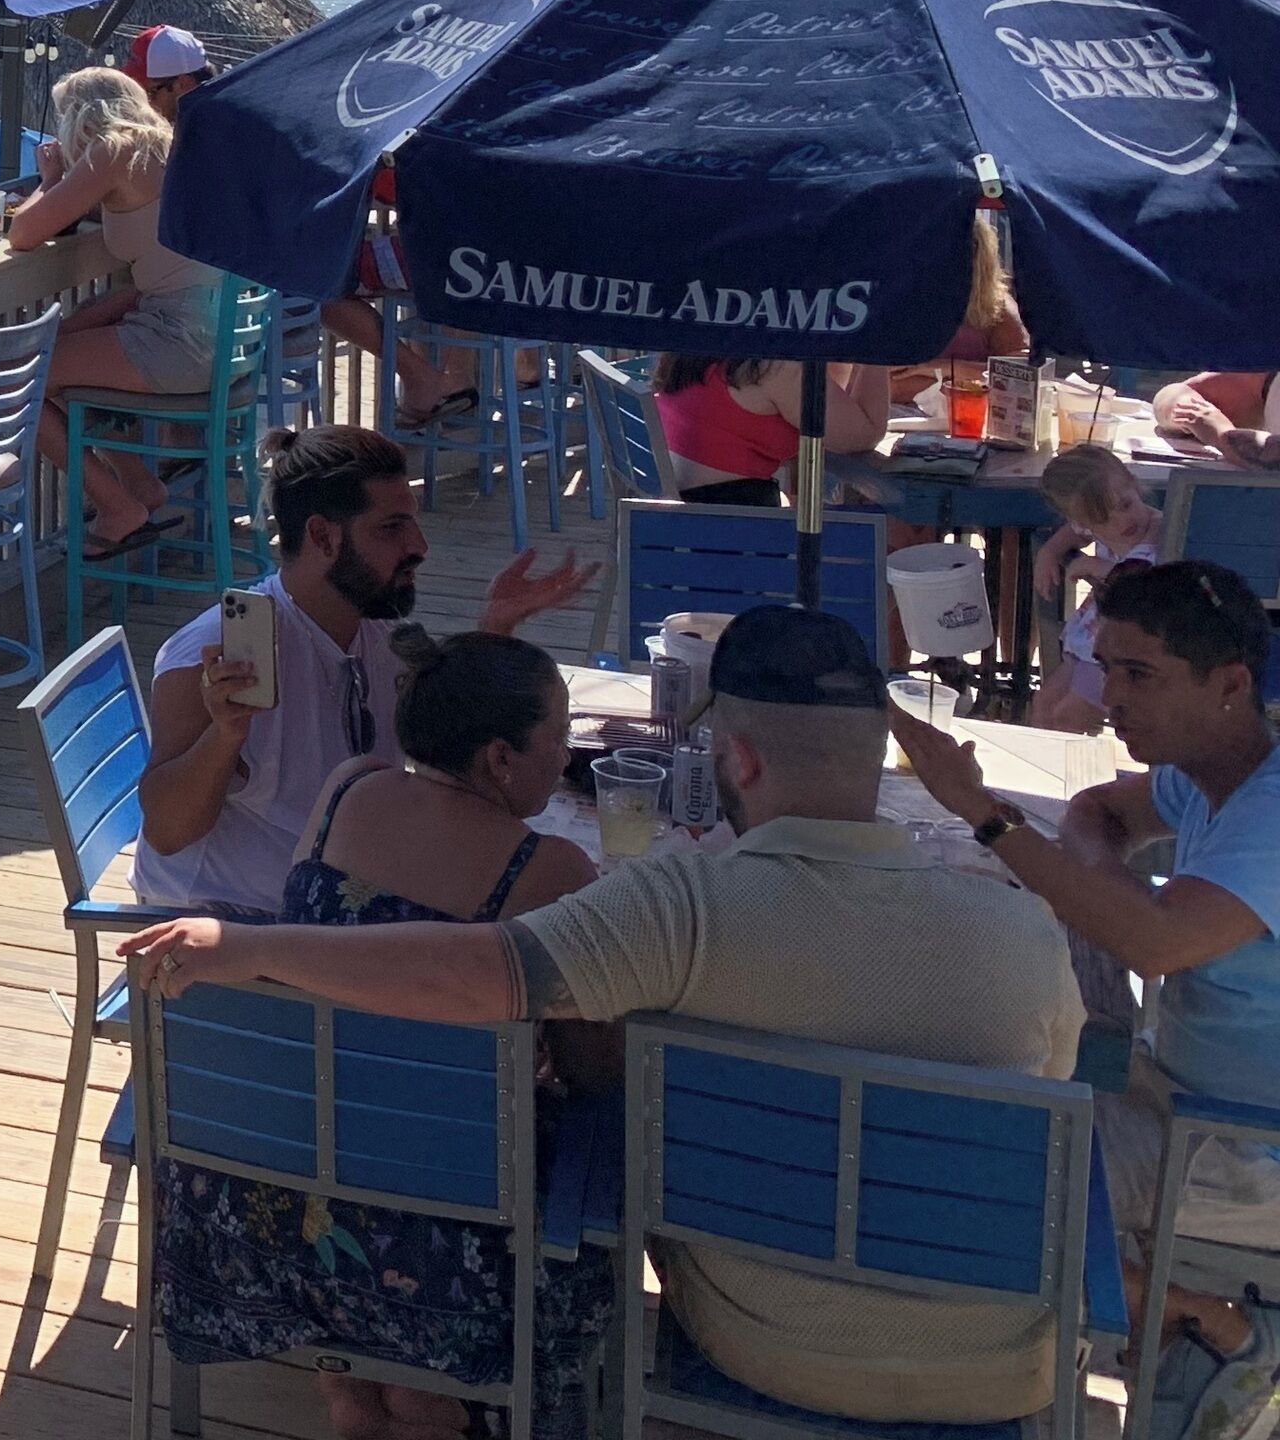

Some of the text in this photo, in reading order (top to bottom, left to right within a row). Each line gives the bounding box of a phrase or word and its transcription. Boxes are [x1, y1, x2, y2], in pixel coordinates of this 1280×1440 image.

[395, 3, 518, 53] SAMUEL
[725, 7, 895, 35] Patriot
[365, 36, 477, 80] ADAMS
[994, 26, 1212, 69] SAMUEL
[1040, 64, 1219, 102] ADAMS
[697, 99, 877, 123] Patriot
[444, 246, 872, 333] SAMUEL ADAMS
[994, 362, 1033, 381] DESSERTS
[685, 767, 704, 822] Corona
